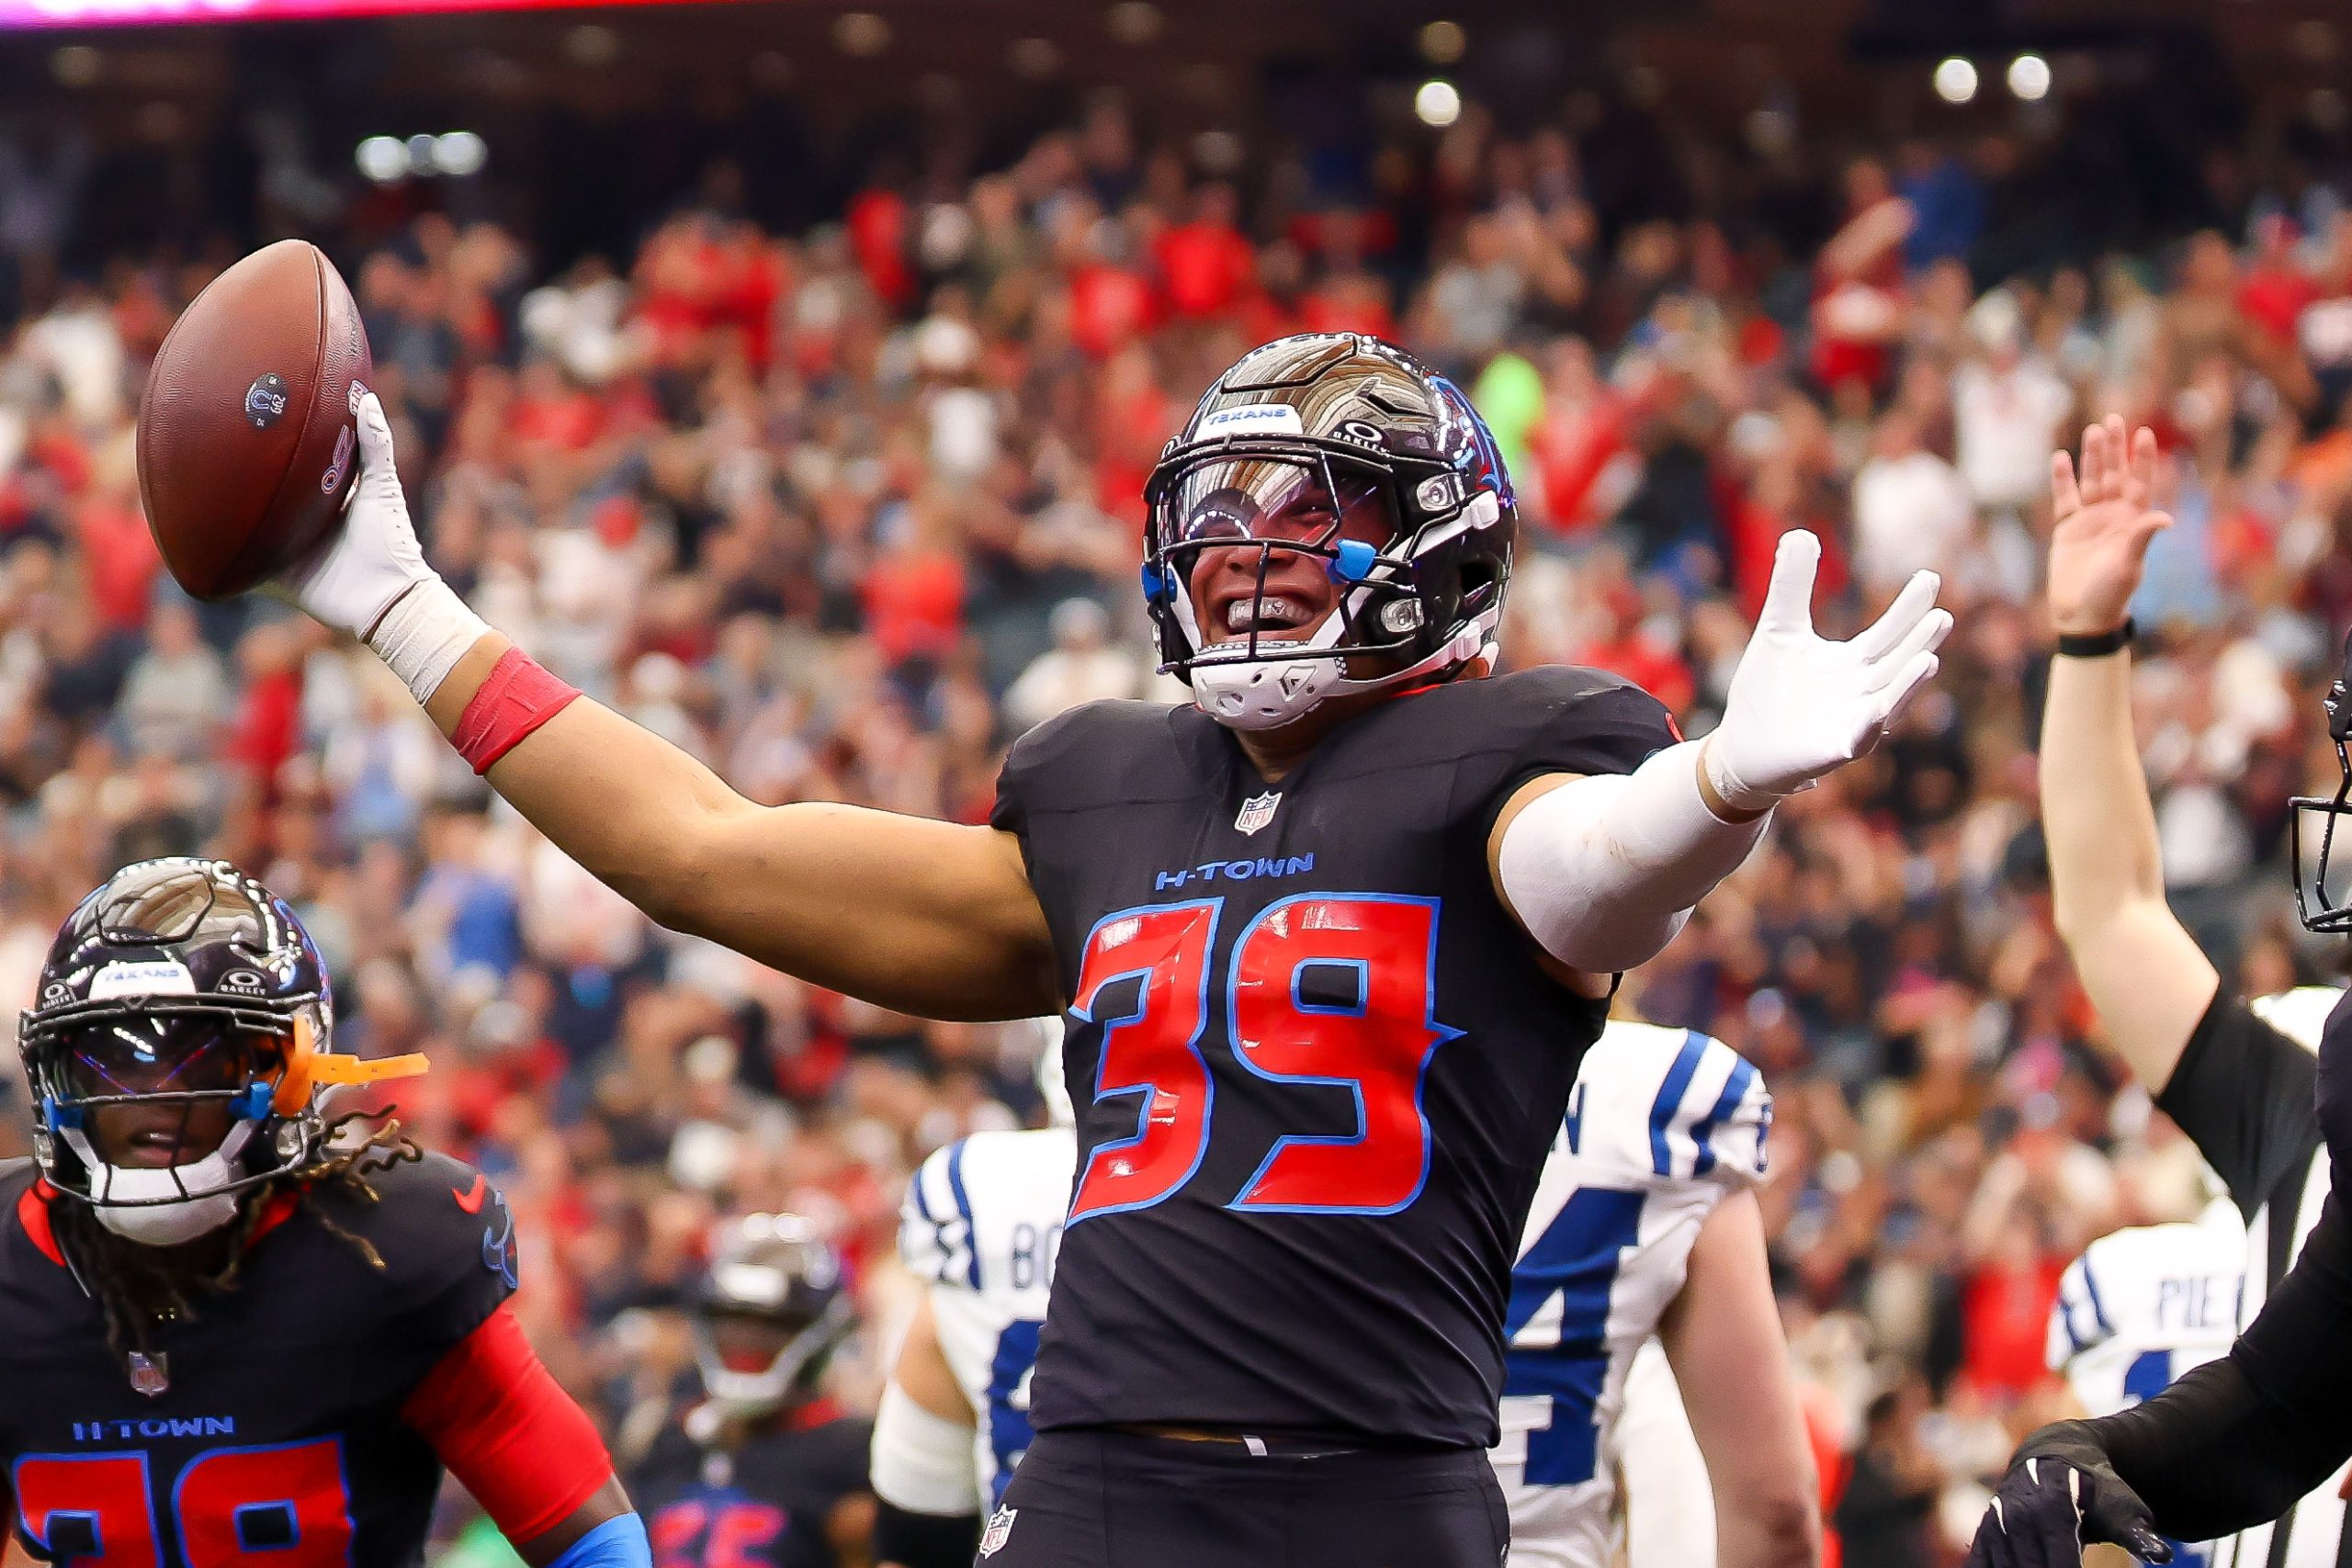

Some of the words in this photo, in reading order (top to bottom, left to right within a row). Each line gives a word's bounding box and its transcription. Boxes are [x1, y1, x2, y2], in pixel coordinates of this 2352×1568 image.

[1207, 409, 1286, 425] TEXANS
[1333, 431, 1391, 457] OAKLEY
[1243, 809, 1268, 827] NFL
[1155, 852, 1315, 891] H-TOWN
[220, 985, 266, 996] OAKLEY
[1066, 891, 1467, 1230] 39
[983, 1529, 1002, 1548] NFL
